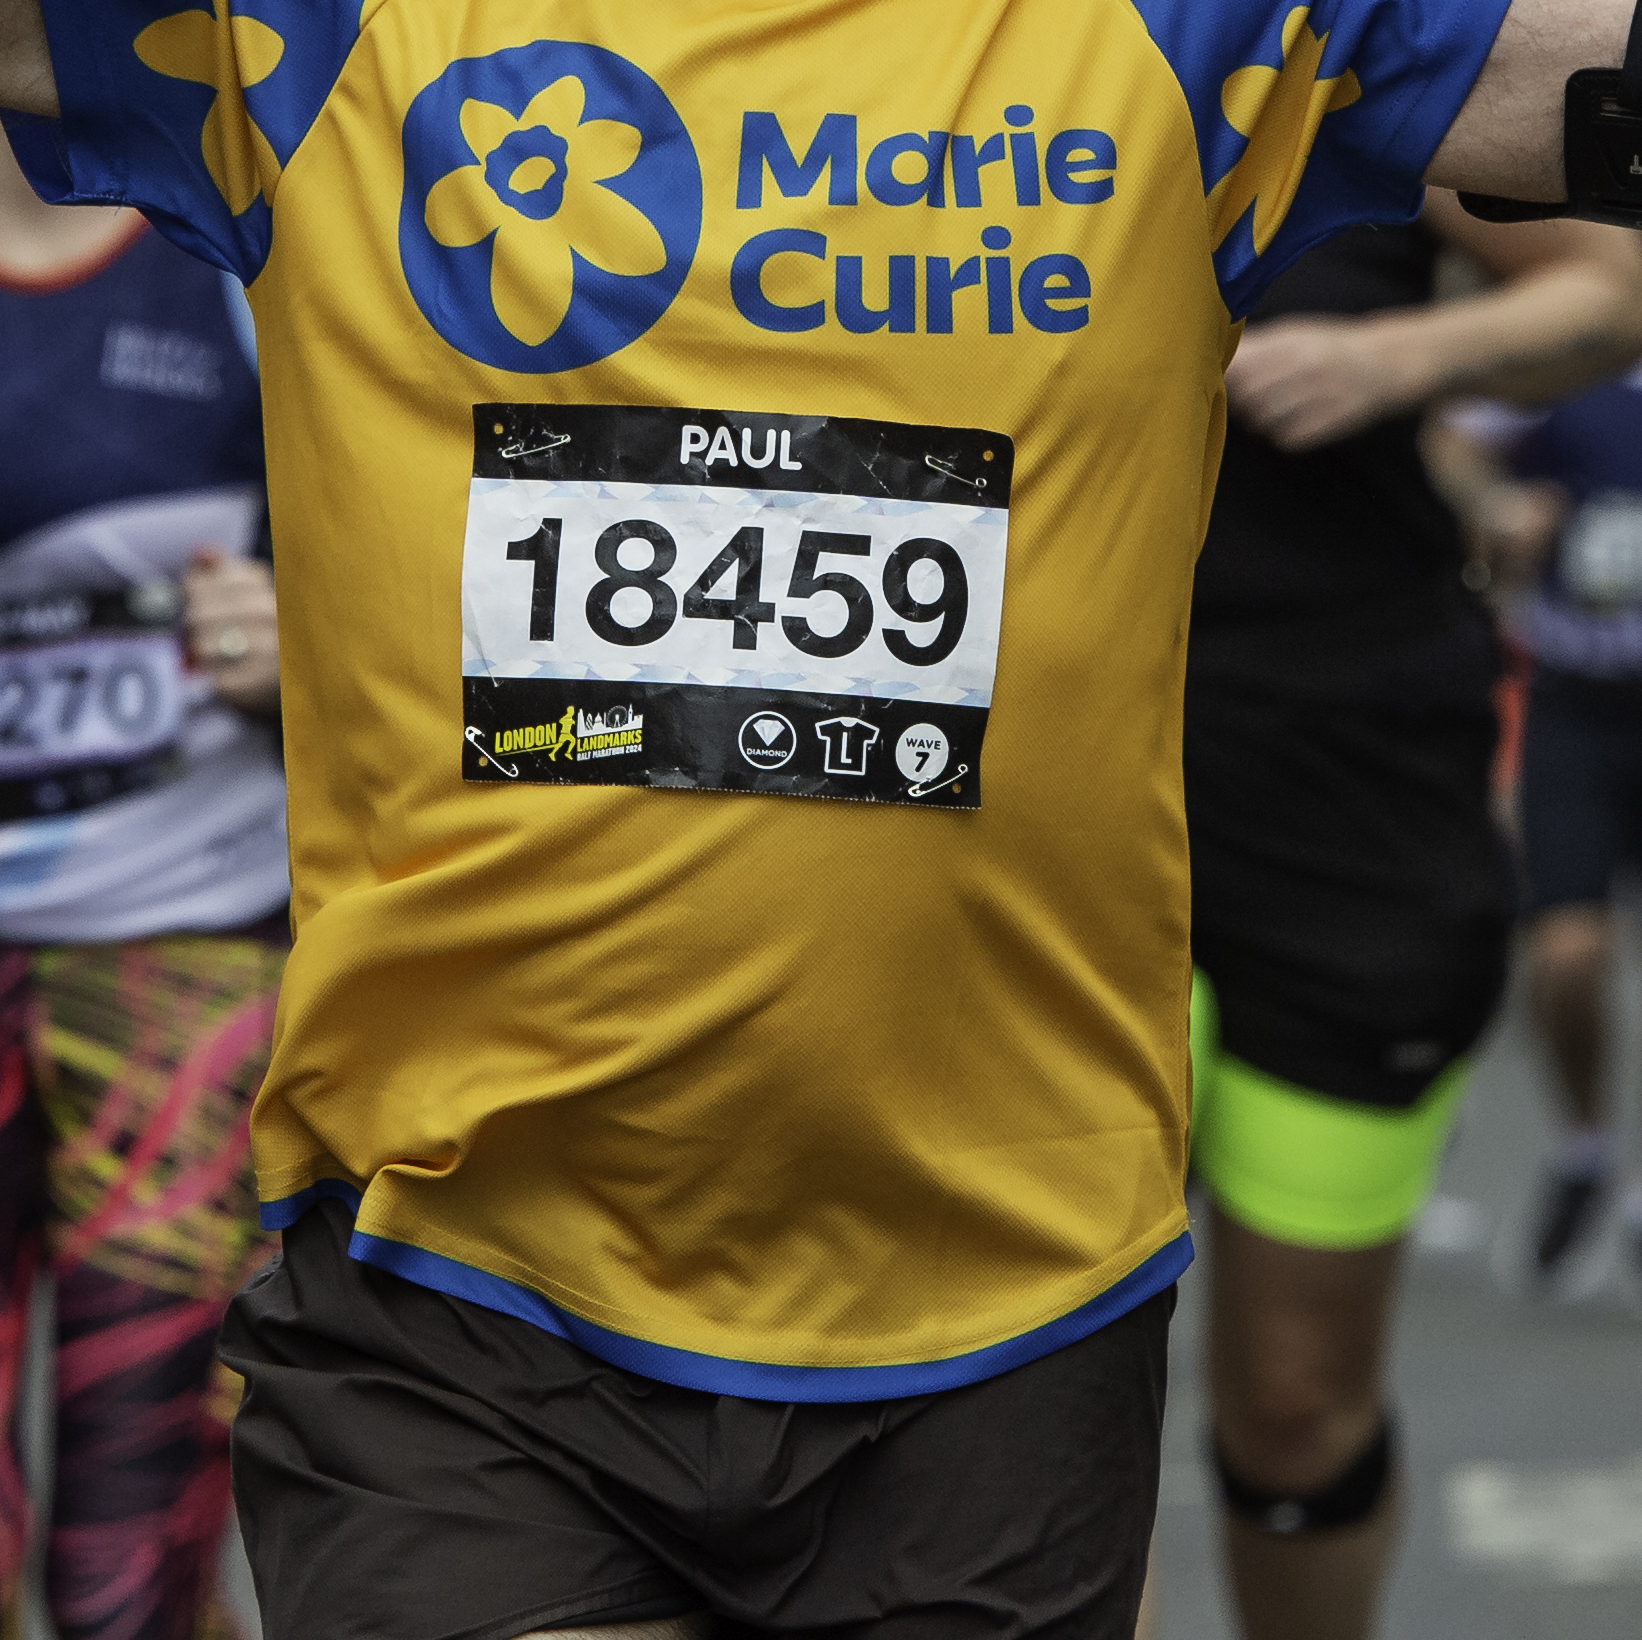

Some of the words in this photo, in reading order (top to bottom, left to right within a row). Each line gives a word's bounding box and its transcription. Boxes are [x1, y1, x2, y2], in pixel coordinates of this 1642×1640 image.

[735, 104, 1117, 210] Marie
[729, 226, 1092, 335] Curie
[680, 425, 803, 472] PAUL
[505, 516, 970, 668] 18459
[495, 722, 557, 753] LONDON
[576, 729, 643, 752] LANDMARKS
[625, 744, 642, 754] 2024
[746, 748, 788, 759] DIAMOND
[840, 731, 852, 764] L
[905, 737, 942, 751] WAVE
[914, 751, 930, 773] 7
